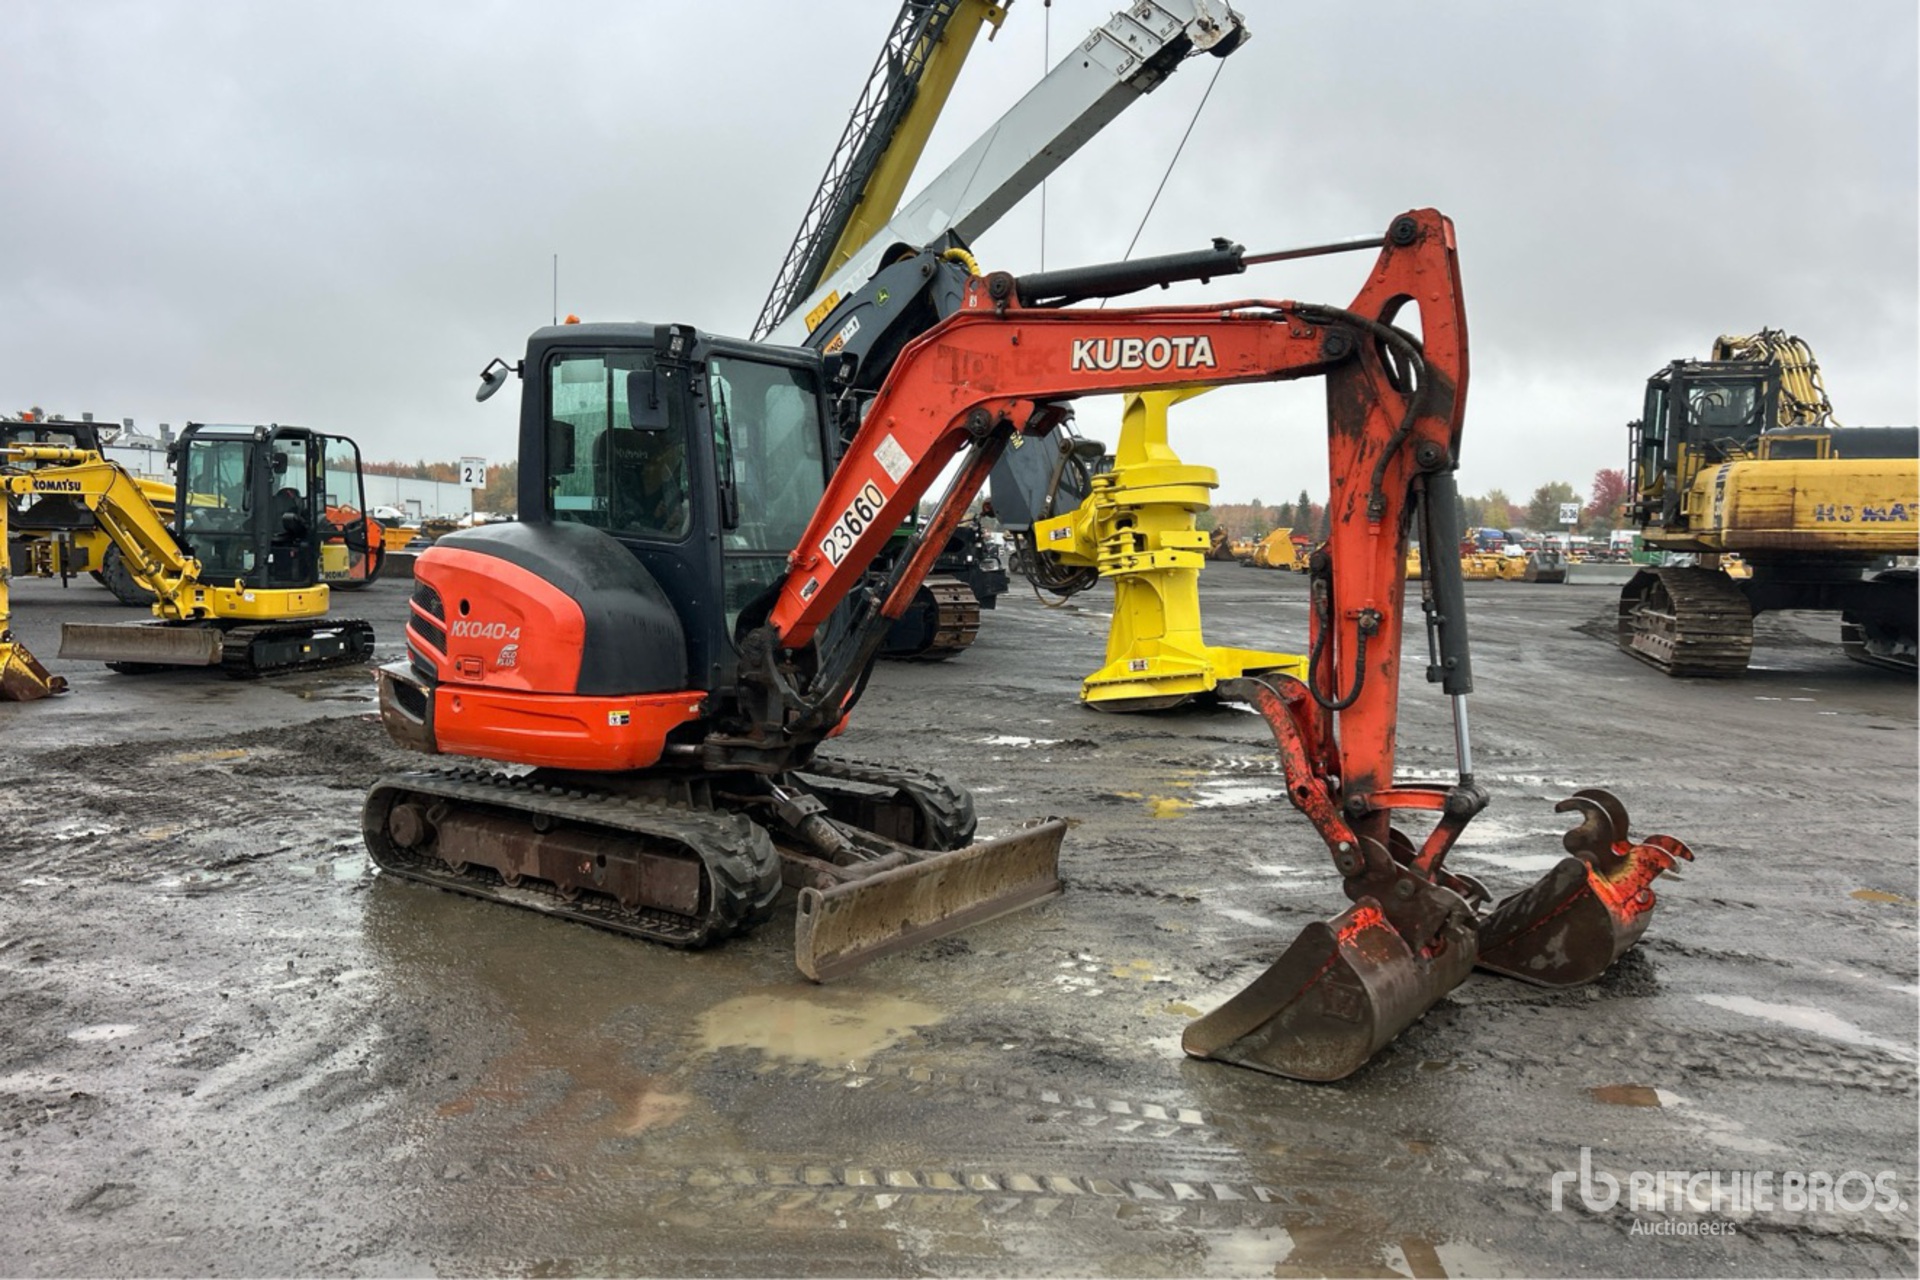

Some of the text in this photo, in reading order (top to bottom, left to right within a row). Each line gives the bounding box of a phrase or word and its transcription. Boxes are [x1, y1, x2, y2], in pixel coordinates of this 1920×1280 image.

[1071, 336, 1218, 371] KUBOTA
[465, 467, 472, 482] 2
[823, 483, 884, 565] 23660
